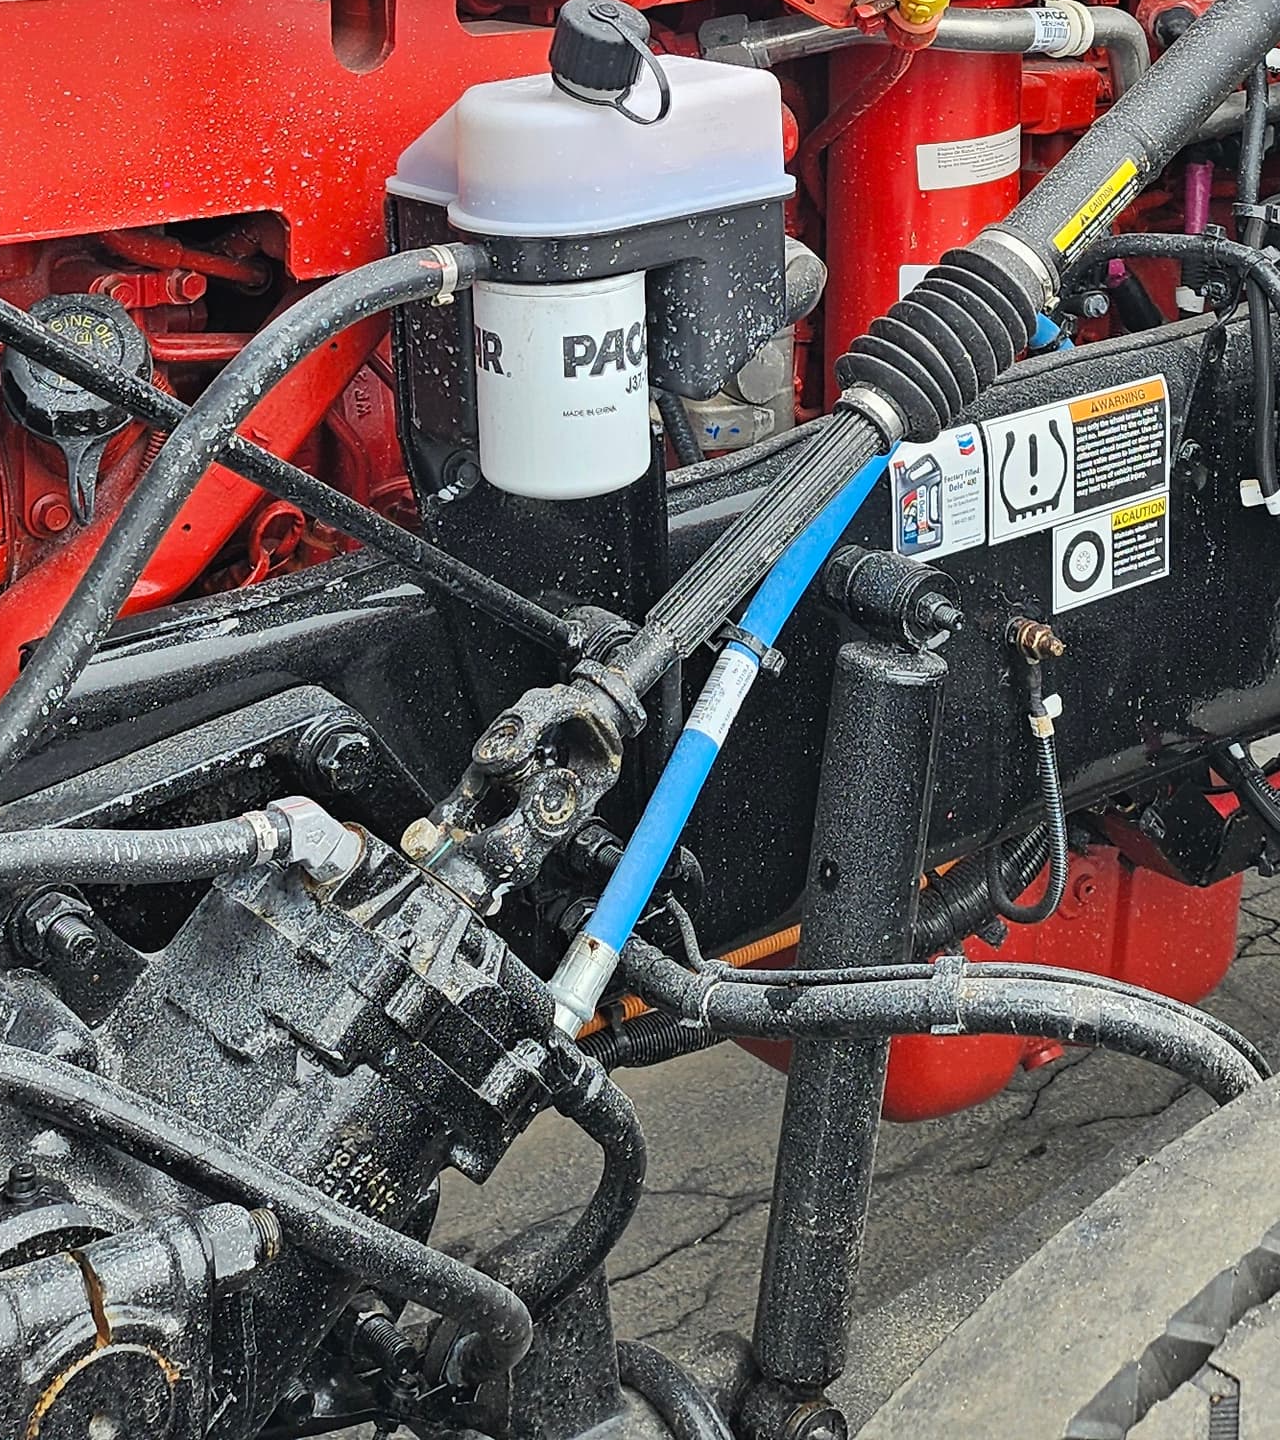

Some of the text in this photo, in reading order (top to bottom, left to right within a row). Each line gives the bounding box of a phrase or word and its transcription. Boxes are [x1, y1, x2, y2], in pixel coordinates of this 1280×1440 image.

[1088, 184, 1115, 214] CAUTION
[51, 315, 115, 349] GINE OIL
[1097, 389, 1146, 412] WARNING
[1121, 500, 1165, 524] CAUTION
